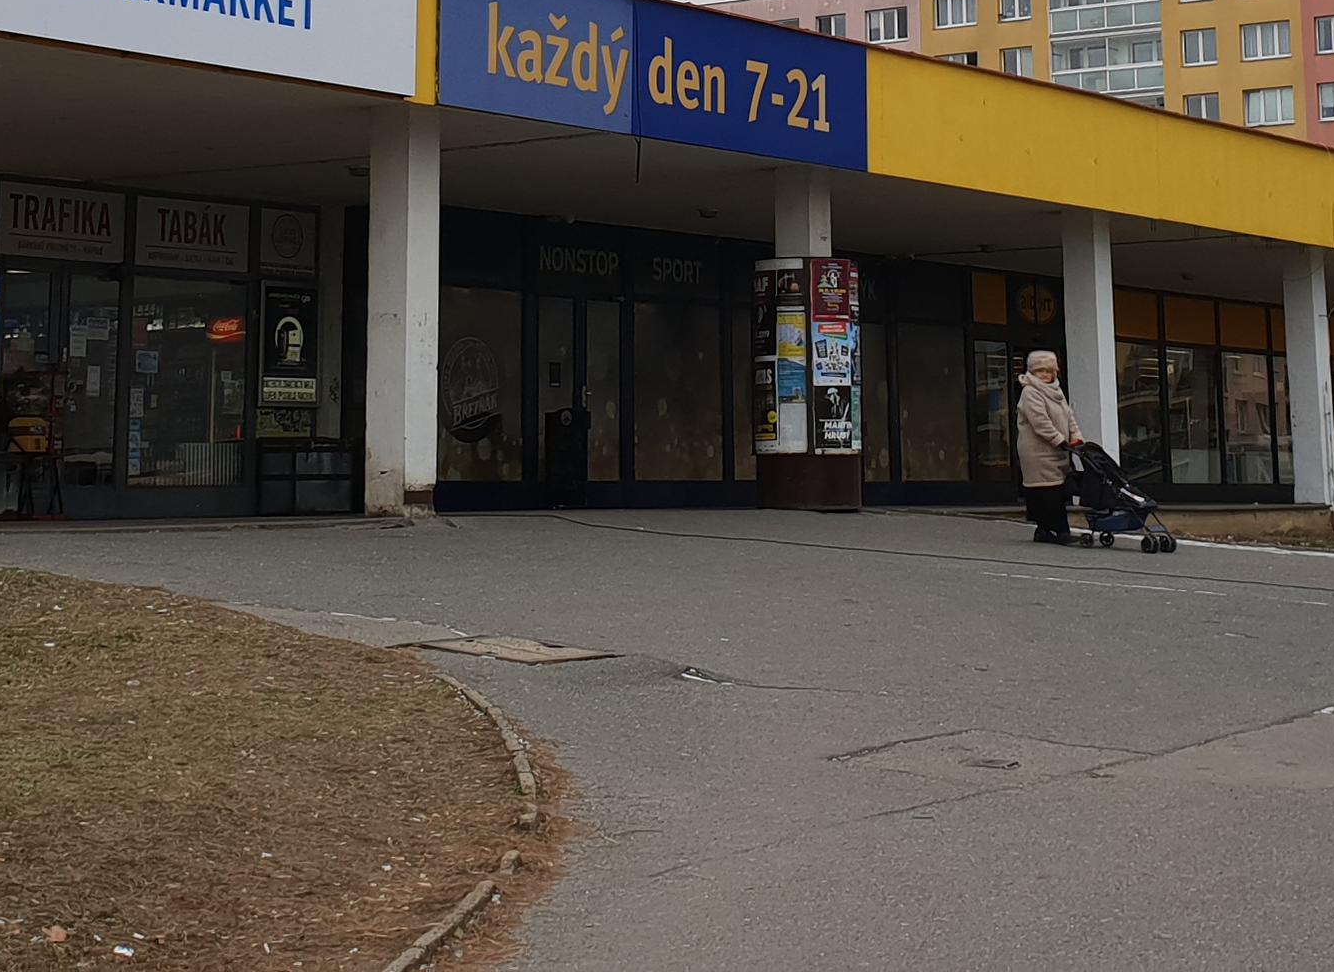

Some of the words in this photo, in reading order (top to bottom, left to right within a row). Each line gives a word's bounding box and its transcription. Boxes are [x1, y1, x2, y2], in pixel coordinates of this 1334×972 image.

[487, 1, 629, 114] každý
[649, 37, 725, 114] den
[746, 60, 830, 132] 7-21
[10, 193, 112, 237] TRAFIKA
[157, 205, 226, 246] TABÁK
[539, 245, 619, 276] NONSTOP
[652, 257, 703, 285] SPORT
